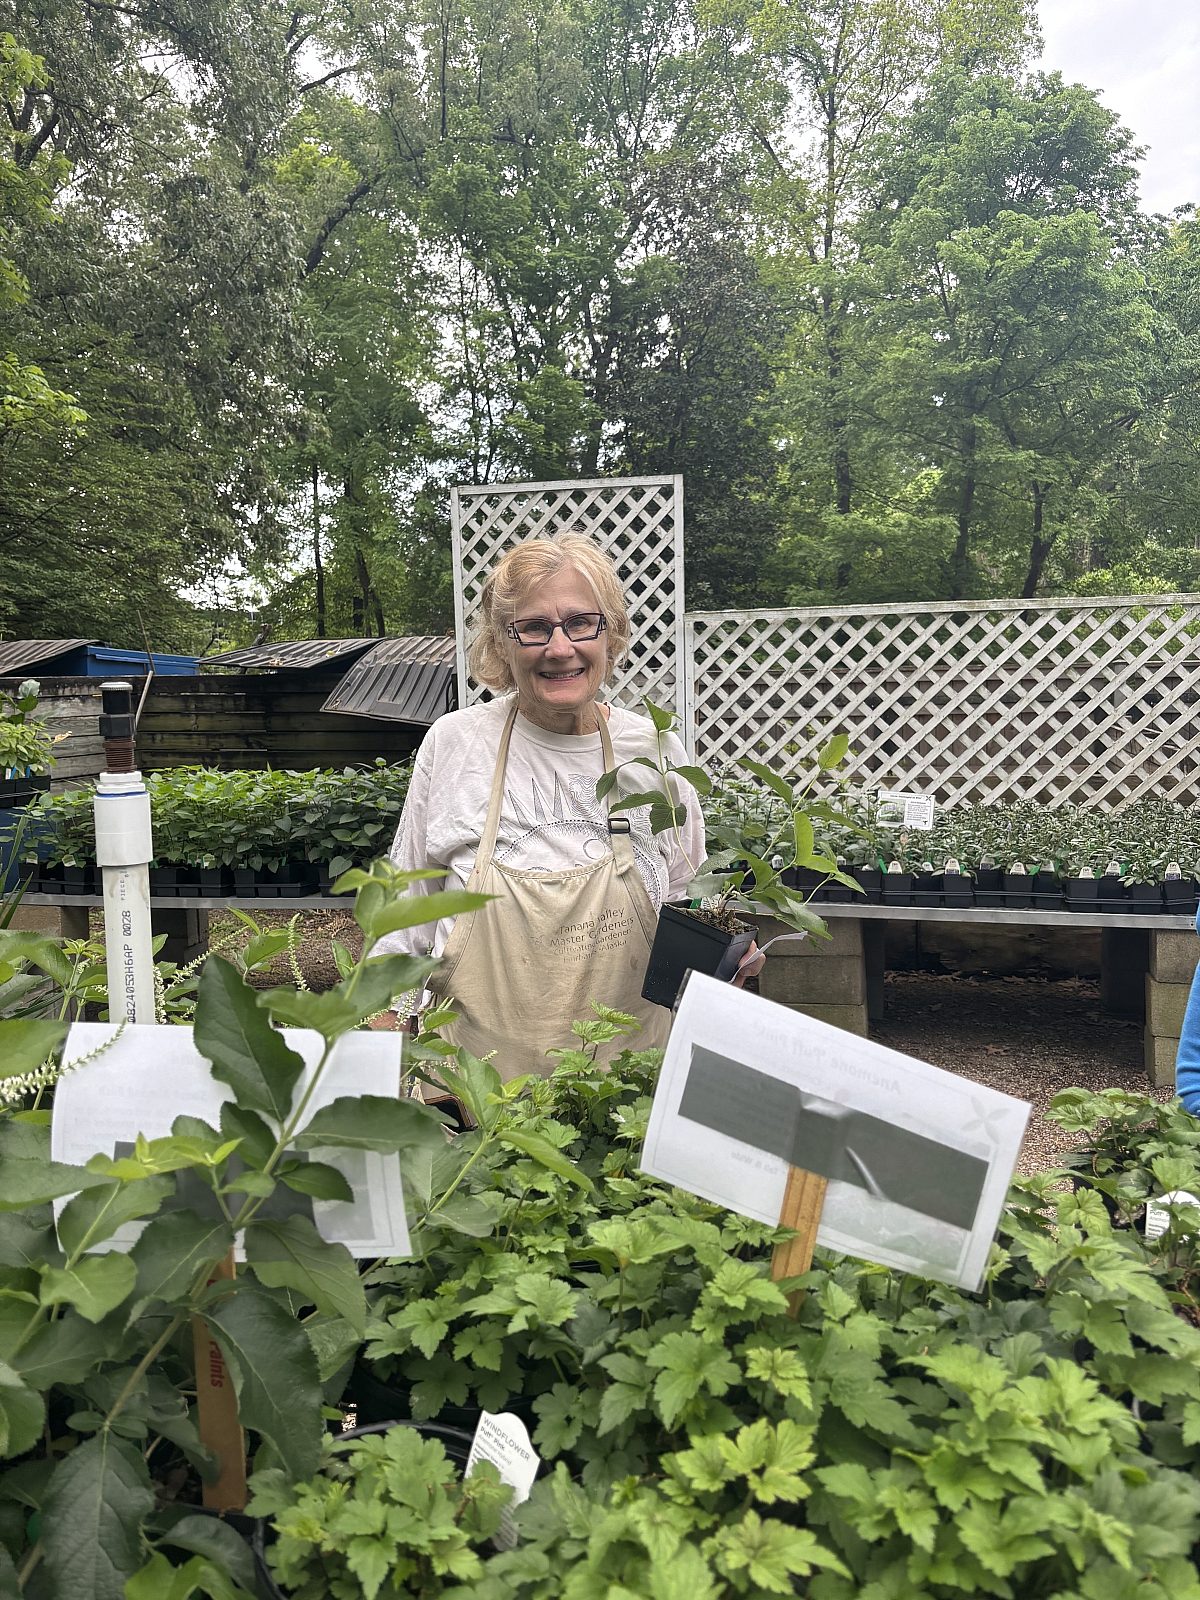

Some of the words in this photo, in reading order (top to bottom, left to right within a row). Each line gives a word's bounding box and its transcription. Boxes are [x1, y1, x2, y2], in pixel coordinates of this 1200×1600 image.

[559, 920, 595, 934] Tanana
[550, 934, 585, 946] Master
[484, 1417, 530, 1461] WINDFLOWER
[494, 1438, 505, 1451] Pink
